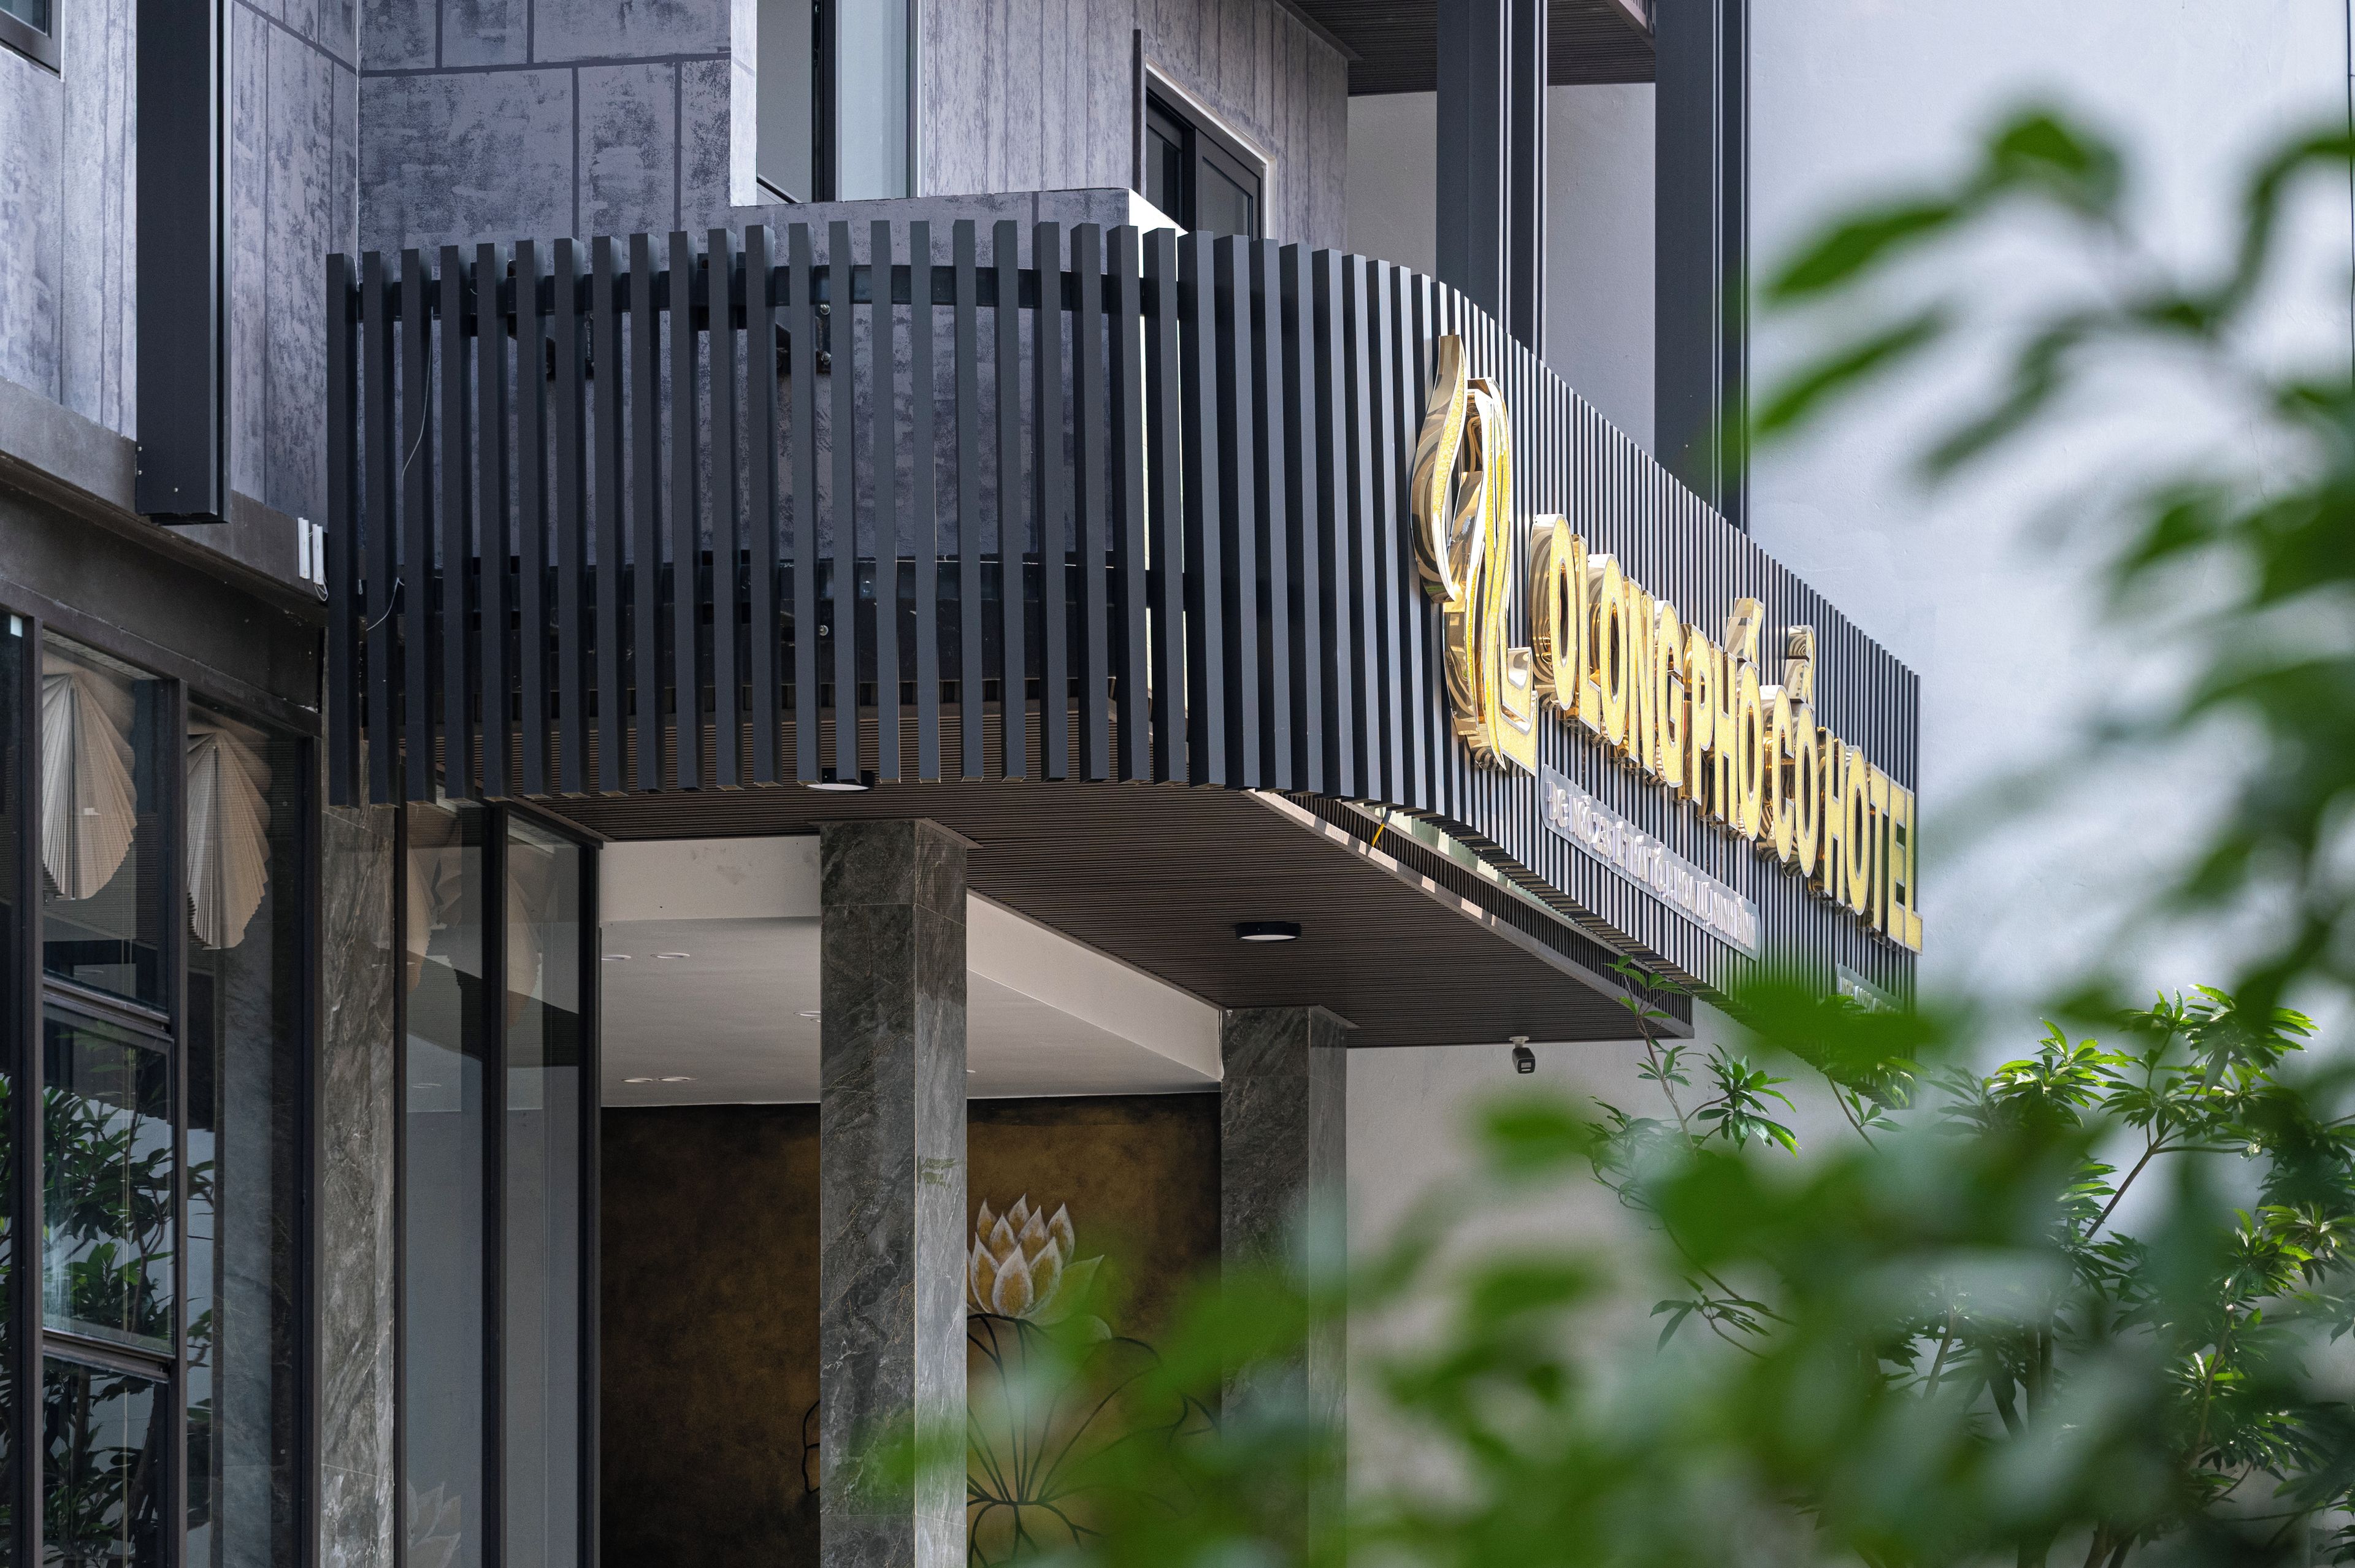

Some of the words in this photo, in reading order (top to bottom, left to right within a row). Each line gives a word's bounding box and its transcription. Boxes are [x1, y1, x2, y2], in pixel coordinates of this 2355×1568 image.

[1687, 597, 1763, 842] PHỐ
[1766, 625, 1816, 878] CỔ
[1821, 726, 1923, 956] HOTEL
[1674, 866, 1696, 913] HOA
